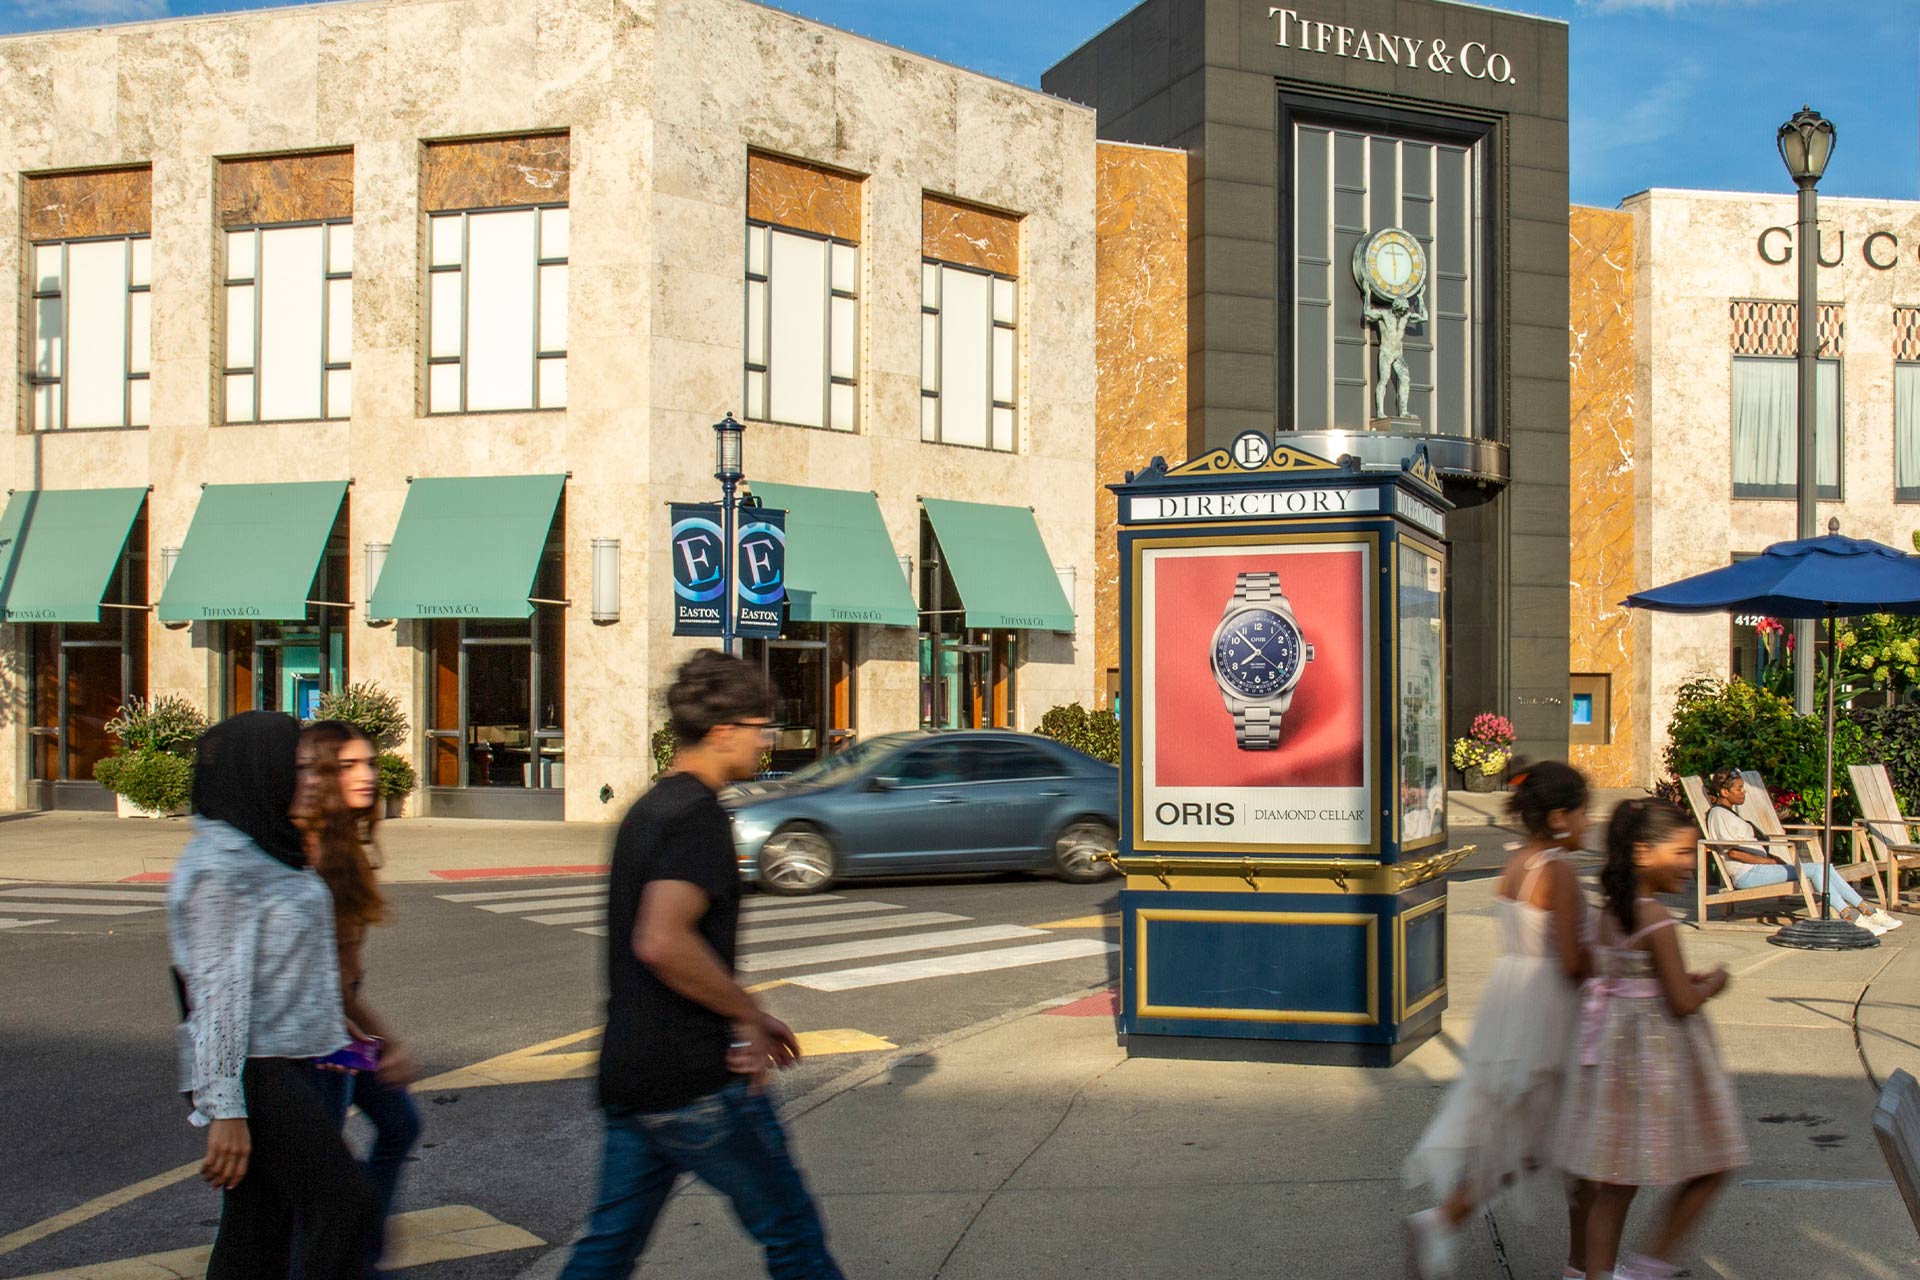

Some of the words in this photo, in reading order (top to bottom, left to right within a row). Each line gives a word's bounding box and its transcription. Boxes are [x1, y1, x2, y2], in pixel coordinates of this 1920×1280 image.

[1268, 6, 1423, 69] TIFFANY
[1427, 38, 1455, 75] &
[1459, 41, 1517, 85] CO.
[1757, 226, 1920, 271] GUC
[1241, 437, 1265, 464] E
[1159, 490, 1351, 518] DIRECTORY
[676, 534, 720, 587] E
[742, 538, 780, 590] E
[1155, 802, 1235, 826] ORIS
[1255, 809, 1317, 821] DIAMOND
